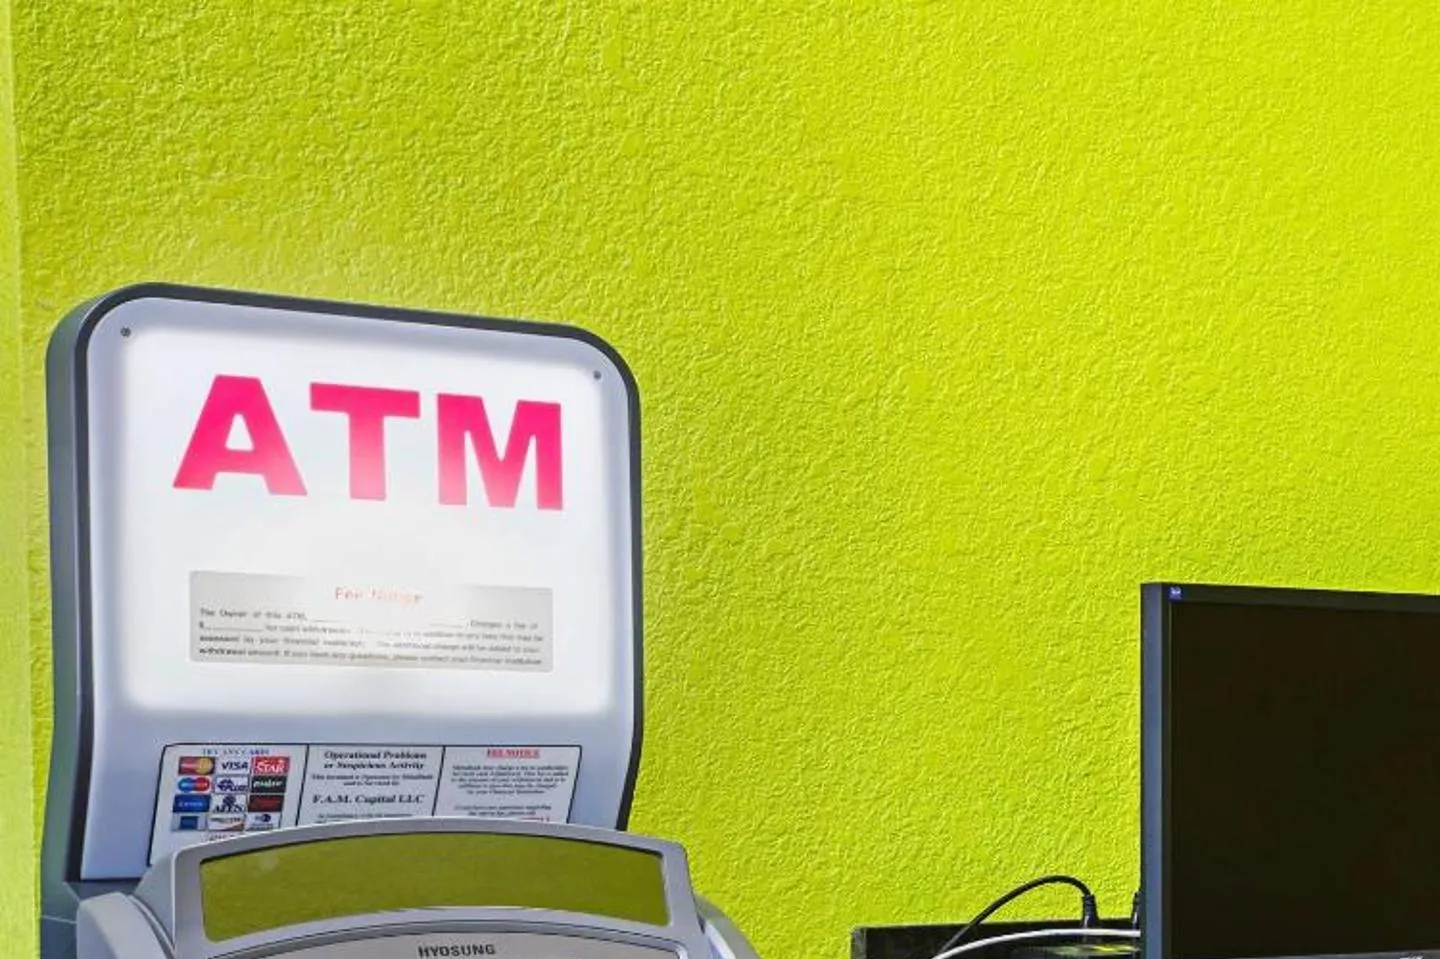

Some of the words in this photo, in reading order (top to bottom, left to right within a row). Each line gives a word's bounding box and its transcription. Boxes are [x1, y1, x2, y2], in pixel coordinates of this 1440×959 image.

[173, 374, 563, 511] ATM
[221, 761, 248, 771] VISA
[255, 763, 285, 773] STAR
[355, 793, 397, 806] Capital
[399, 793, 426, 804] LLC
[417, 943, 497, 959] HYOSUNG
